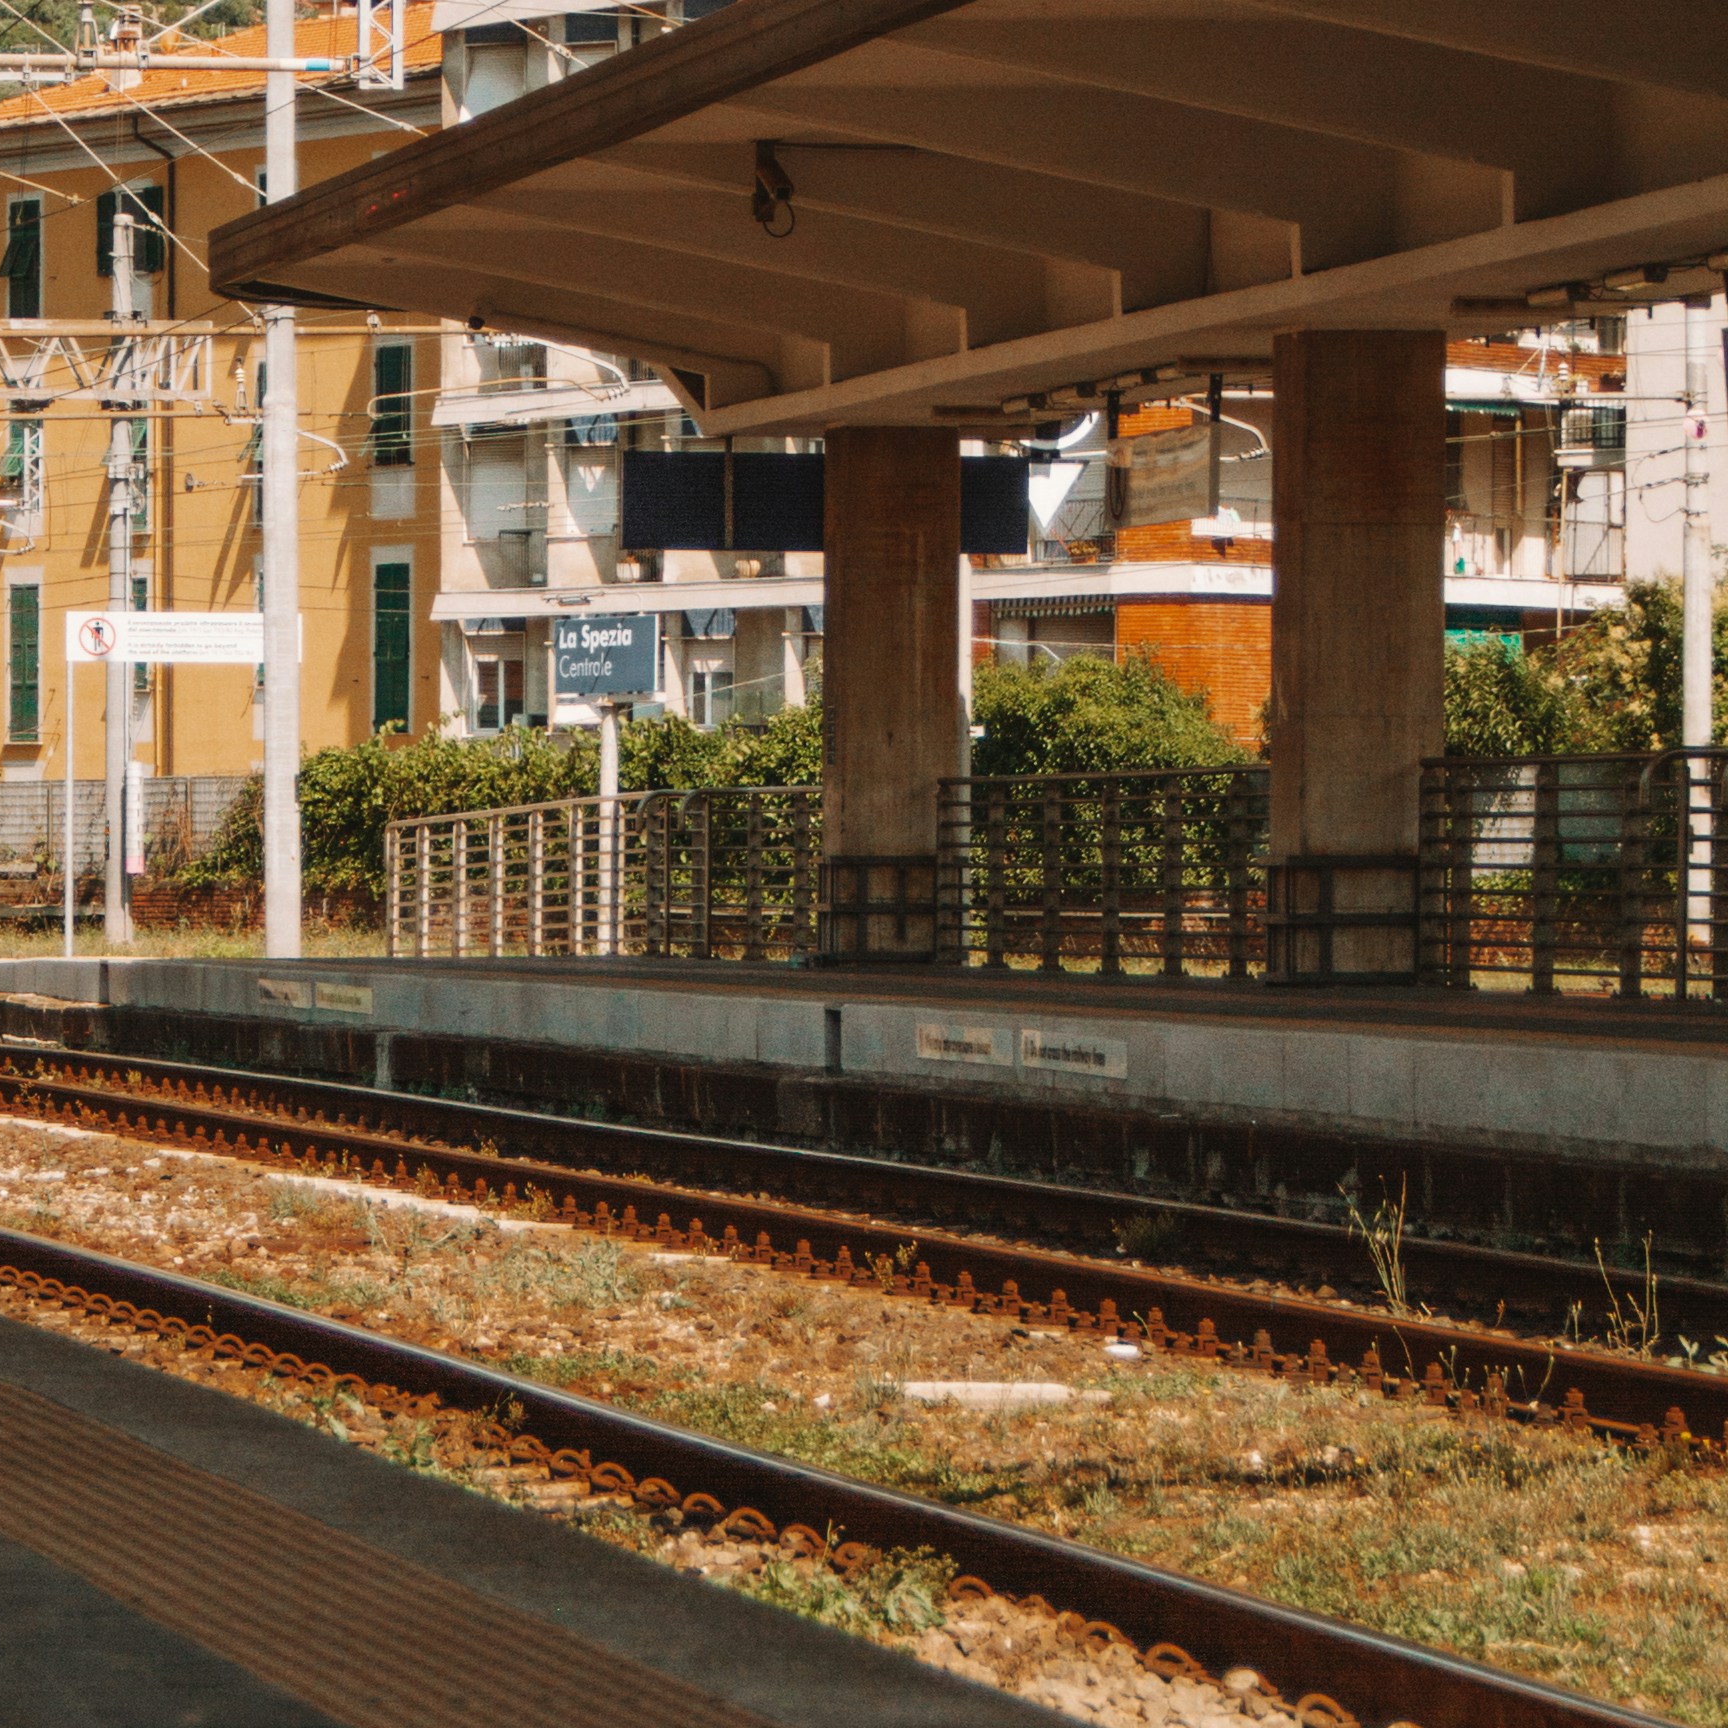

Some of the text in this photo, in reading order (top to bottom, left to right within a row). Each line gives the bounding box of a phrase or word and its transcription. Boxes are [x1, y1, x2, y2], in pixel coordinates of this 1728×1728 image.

[559, 622, 632, 654] La Spezia
[559, 652, 612, 678] Centrale
